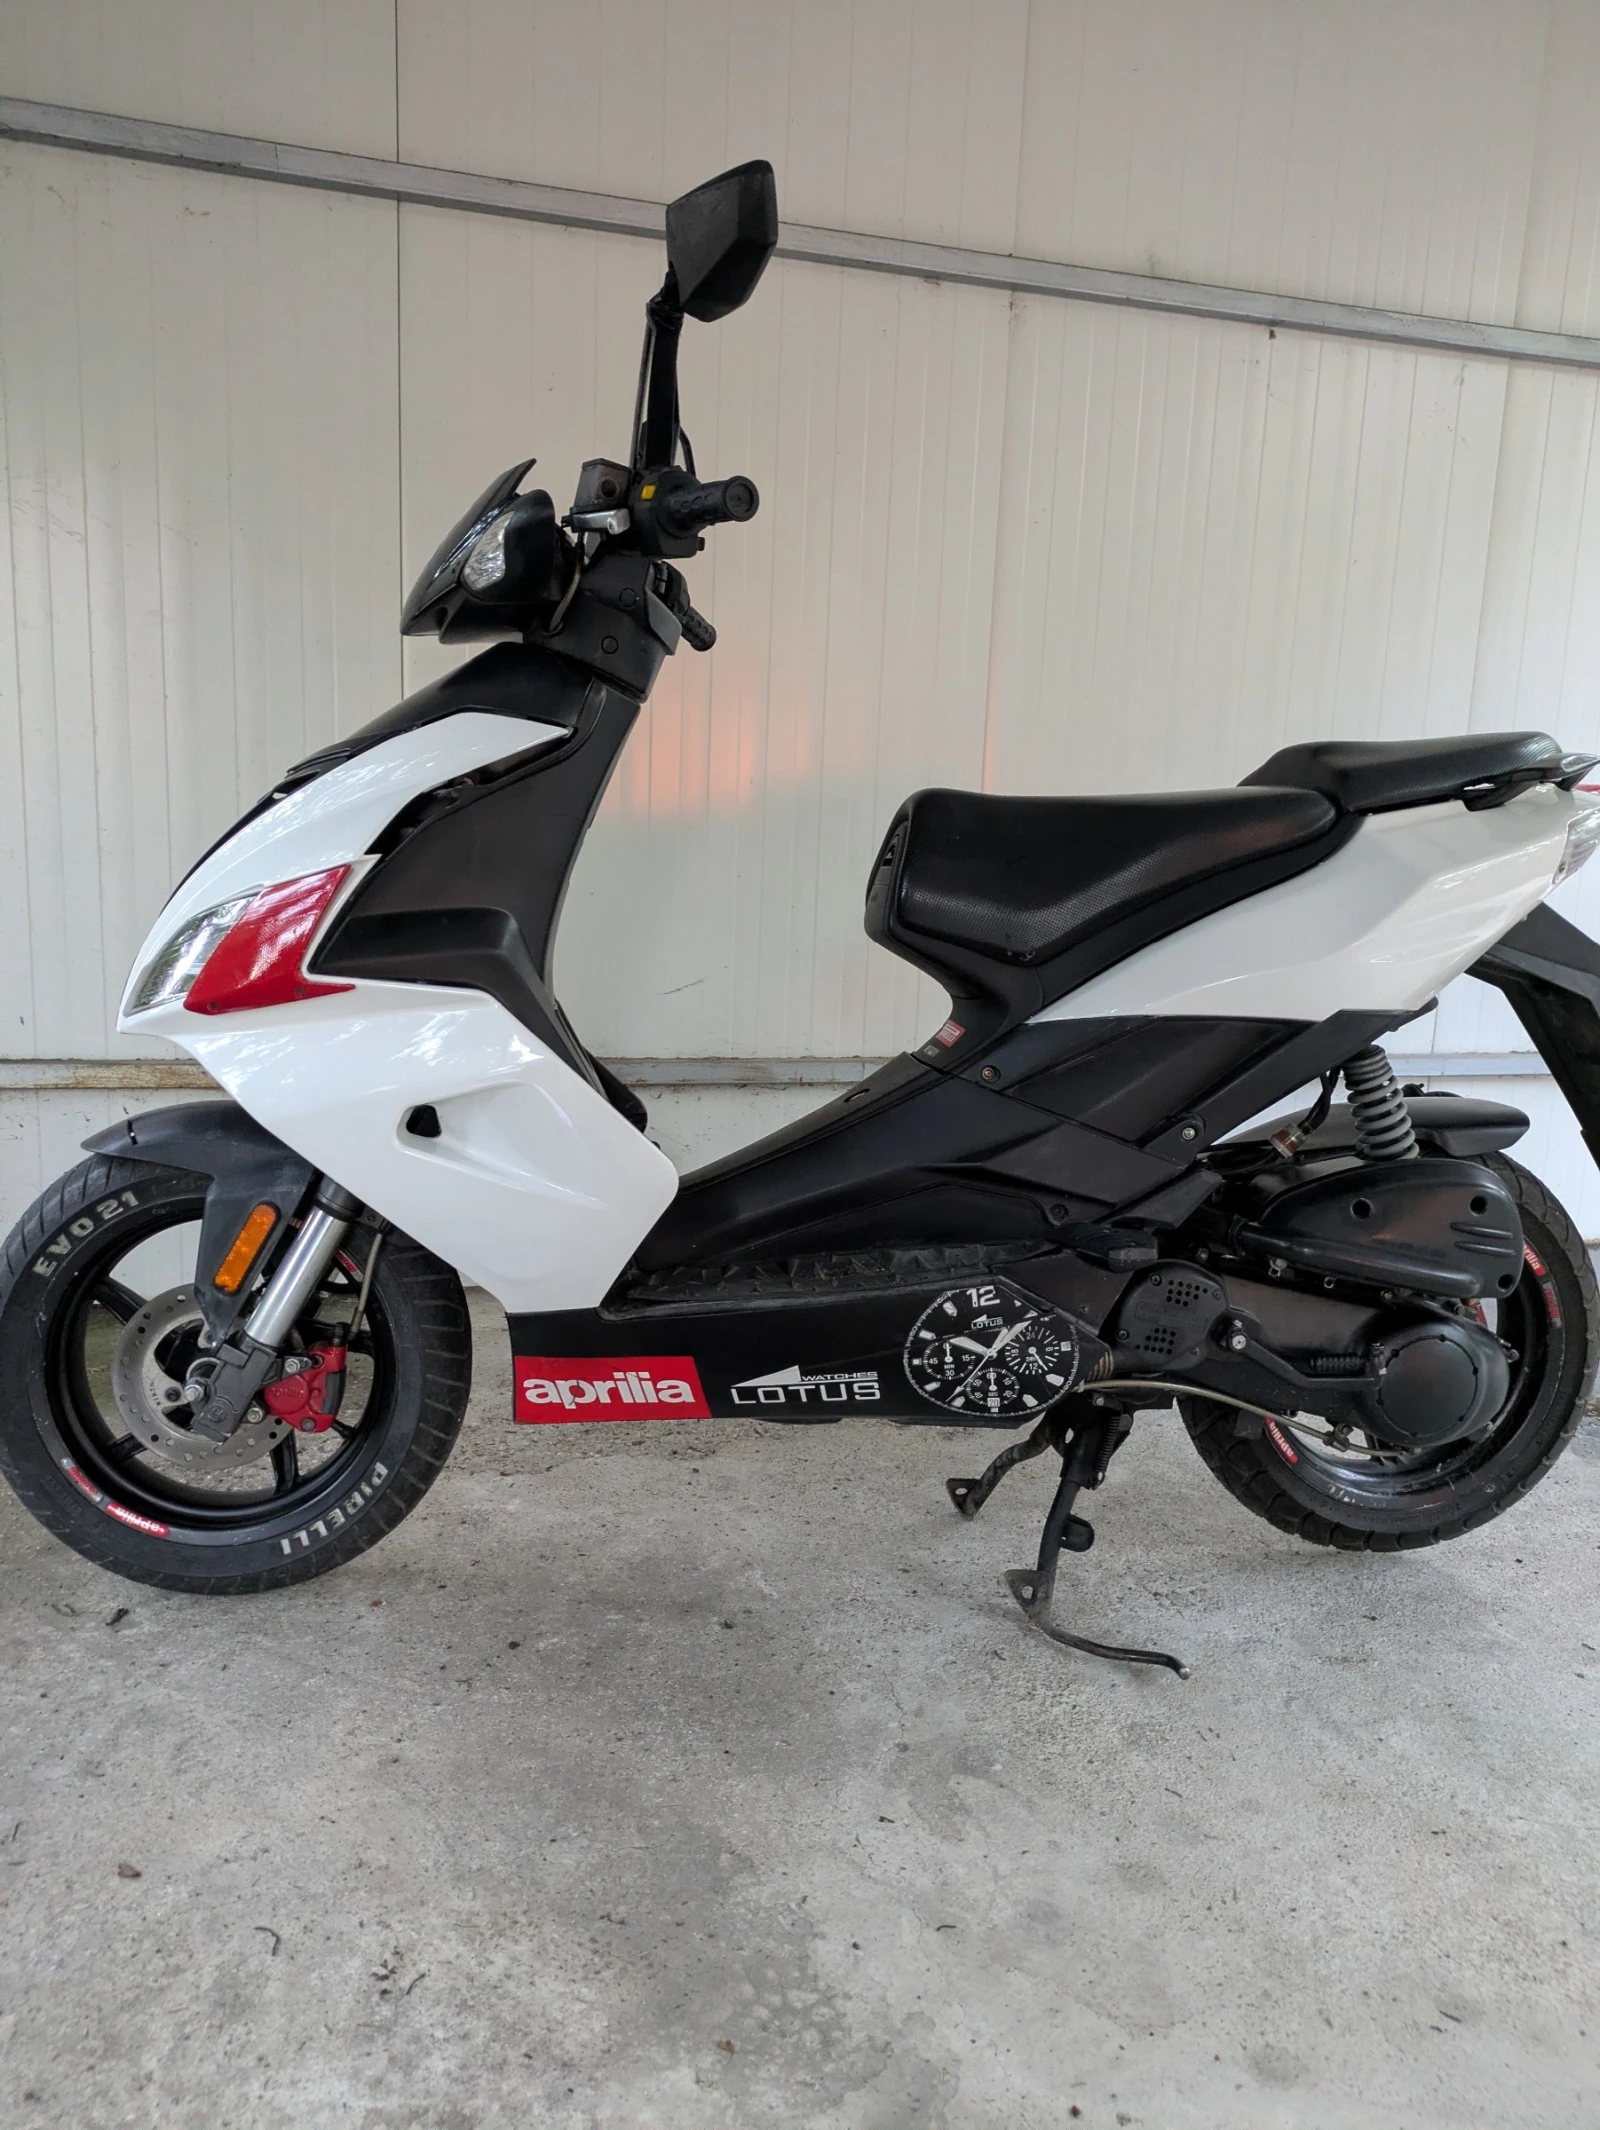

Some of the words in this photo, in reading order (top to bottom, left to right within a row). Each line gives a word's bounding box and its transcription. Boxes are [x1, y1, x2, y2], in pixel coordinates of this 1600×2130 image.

[32, 1216, 94, 1277] EVO
[96, 1191, 139, 1220] 21
[966, 1285, 1001, 1308] 12
[971, 1318, 1004, 1330] LOTUS
[928, 1357, 939, 1365] 45
[961, 1354, 971, 1362] 15
[1029, 1362, 1039, 1371] 12
[802, 1371, 879, 1382] WATCHES
[945, 1369, 956, 1377] 30
[523, 1371, 696, 1410] aprilia
[731, 1382, 881, 1405] LOTUS
[1268, 1421, 1294, 1457] aprilia
[280, 1461, 389, 1555] PIRELLI
